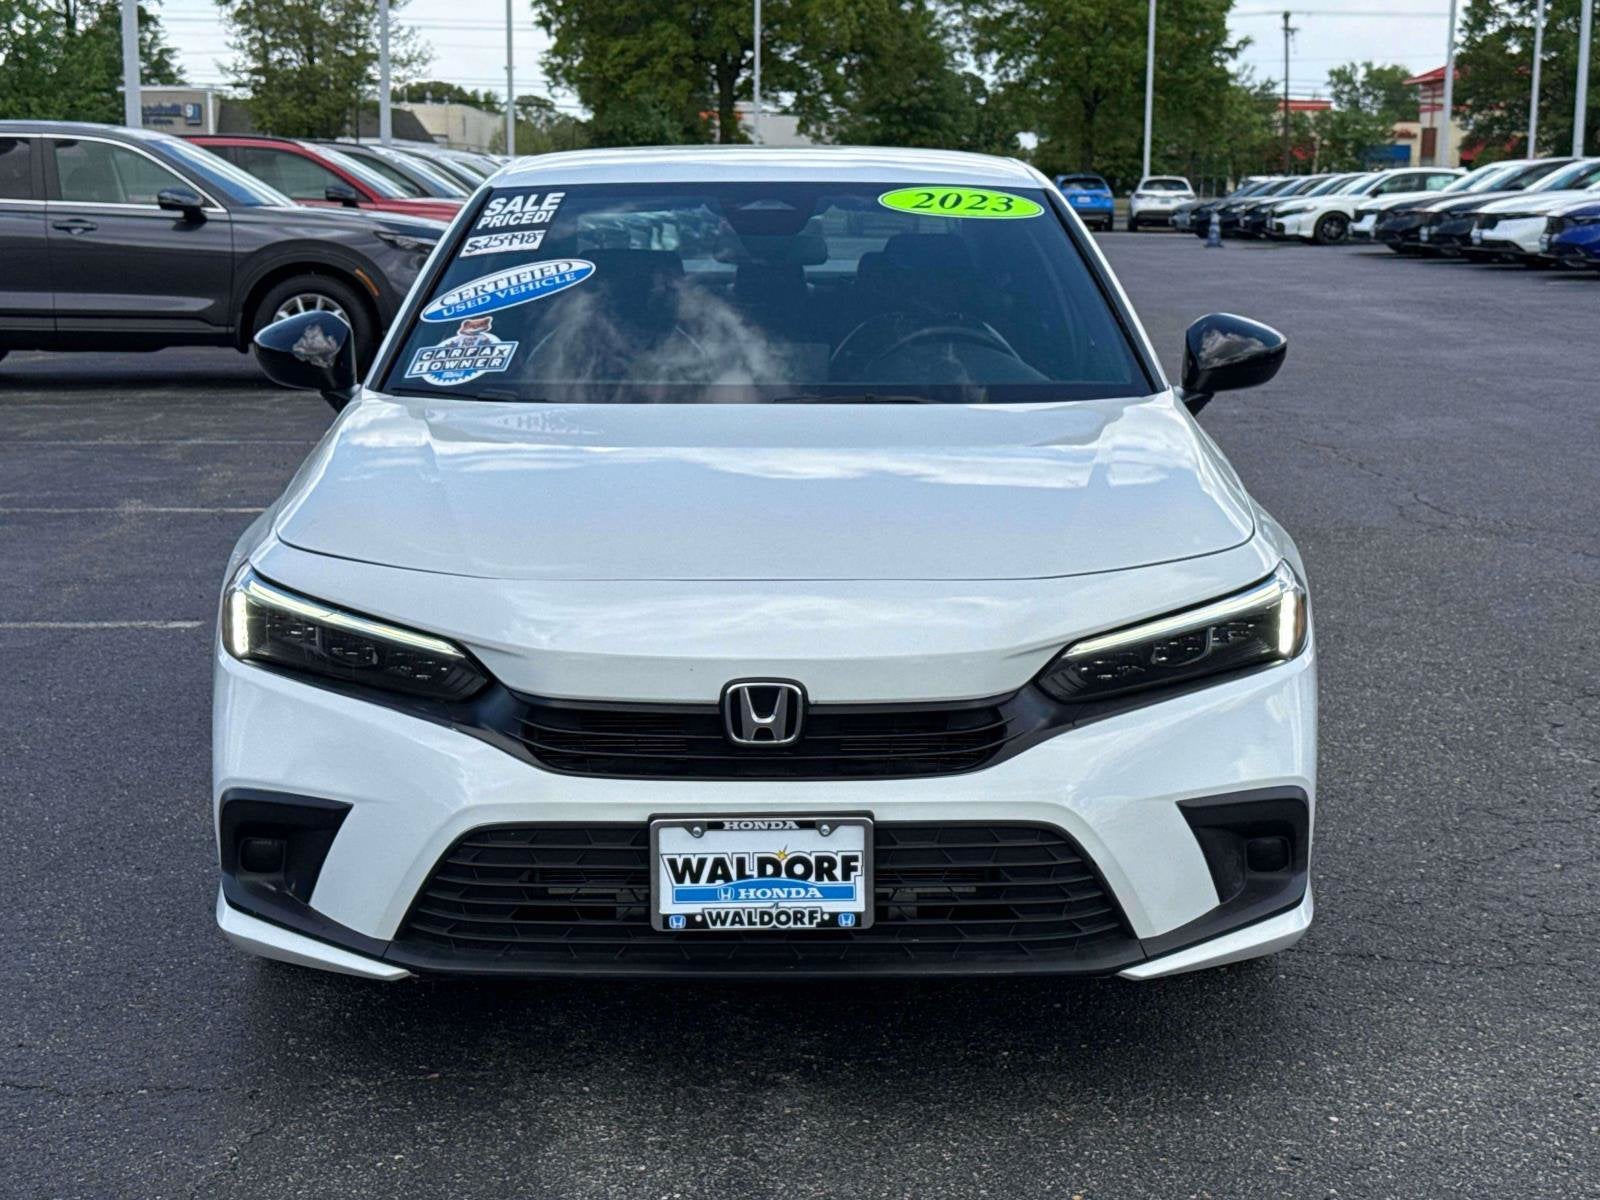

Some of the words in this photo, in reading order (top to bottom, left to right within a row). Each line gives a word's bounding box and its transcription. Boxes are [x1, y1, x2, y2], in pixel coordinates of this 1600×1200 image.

[484, 192, 566, 216] SALE
[911, 192, 1014, 212] 2023
[476, 210, 555, 230] PRICED!
[440, 262, 574, 307] CERTIFIED
[442, 297, 492, 316] USED
[495, 272, 577, 299] VEHICLE
[421, 346, 508, 360] CARFAX
[430, 358, 502, 371] OWNER
[723, 820, 800, 830] HONDA
[667, 854, 859, 884] WALDORF
[738, 887, 824, 899] HONDA
[706, 909, 820, 927] WALDORF
